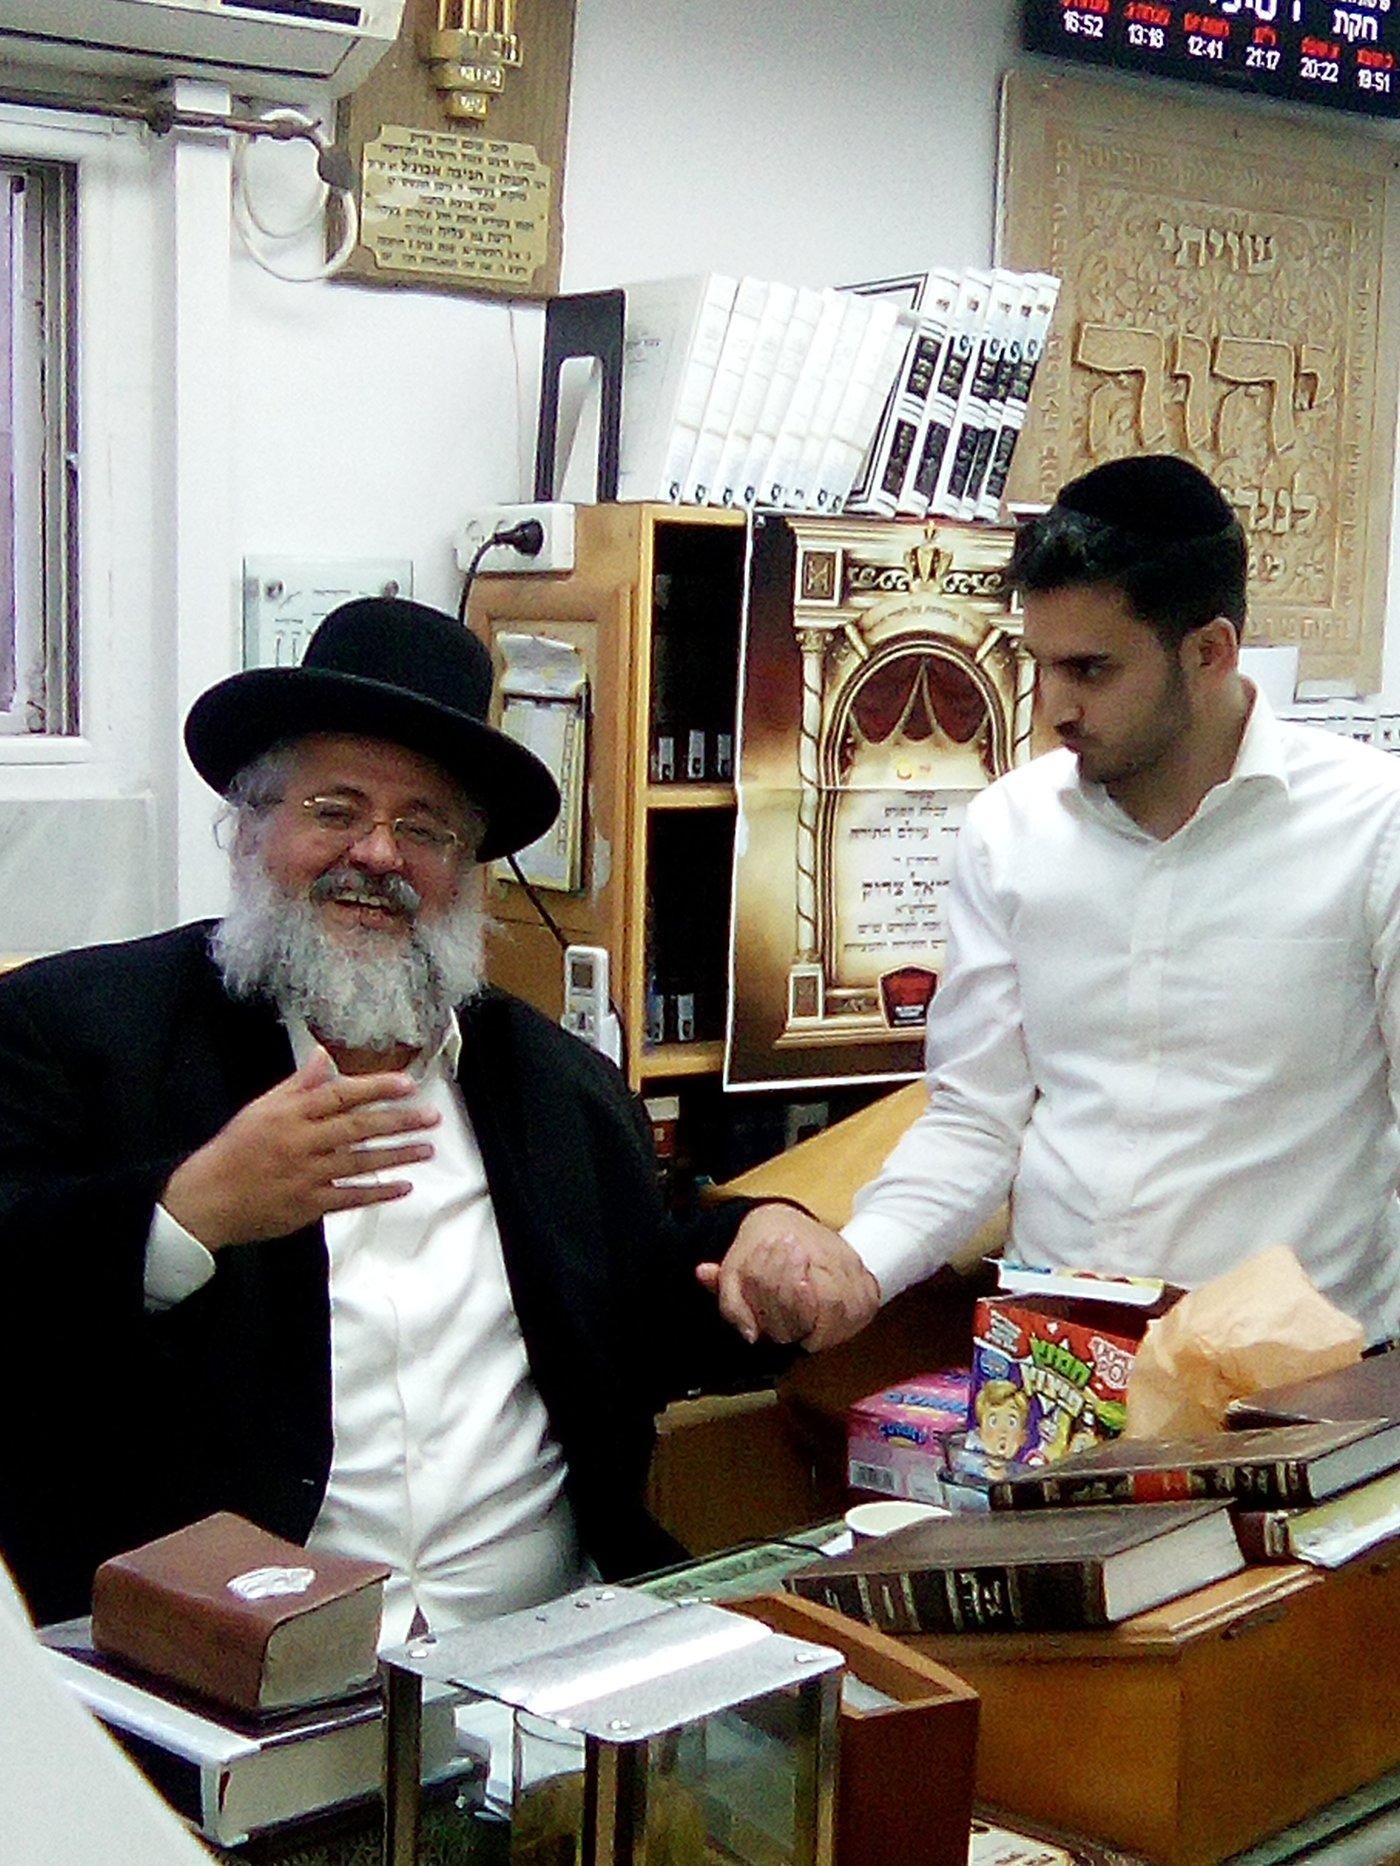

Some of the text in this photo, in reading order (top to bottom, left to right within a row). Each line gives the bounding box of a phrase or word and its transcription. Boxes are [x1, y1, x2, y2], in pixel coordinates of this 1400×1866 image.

[1064, 9, 1104, 38] 16:52
[1246, 47, 1280, 70] 21:17
[1300, 57, 1338, 83] 20:22
[1333, 9, 1378, 42] חקת
[1157, 218, 1277, 275] שויתי
[1072, 320, 1335, 458] יהוה
